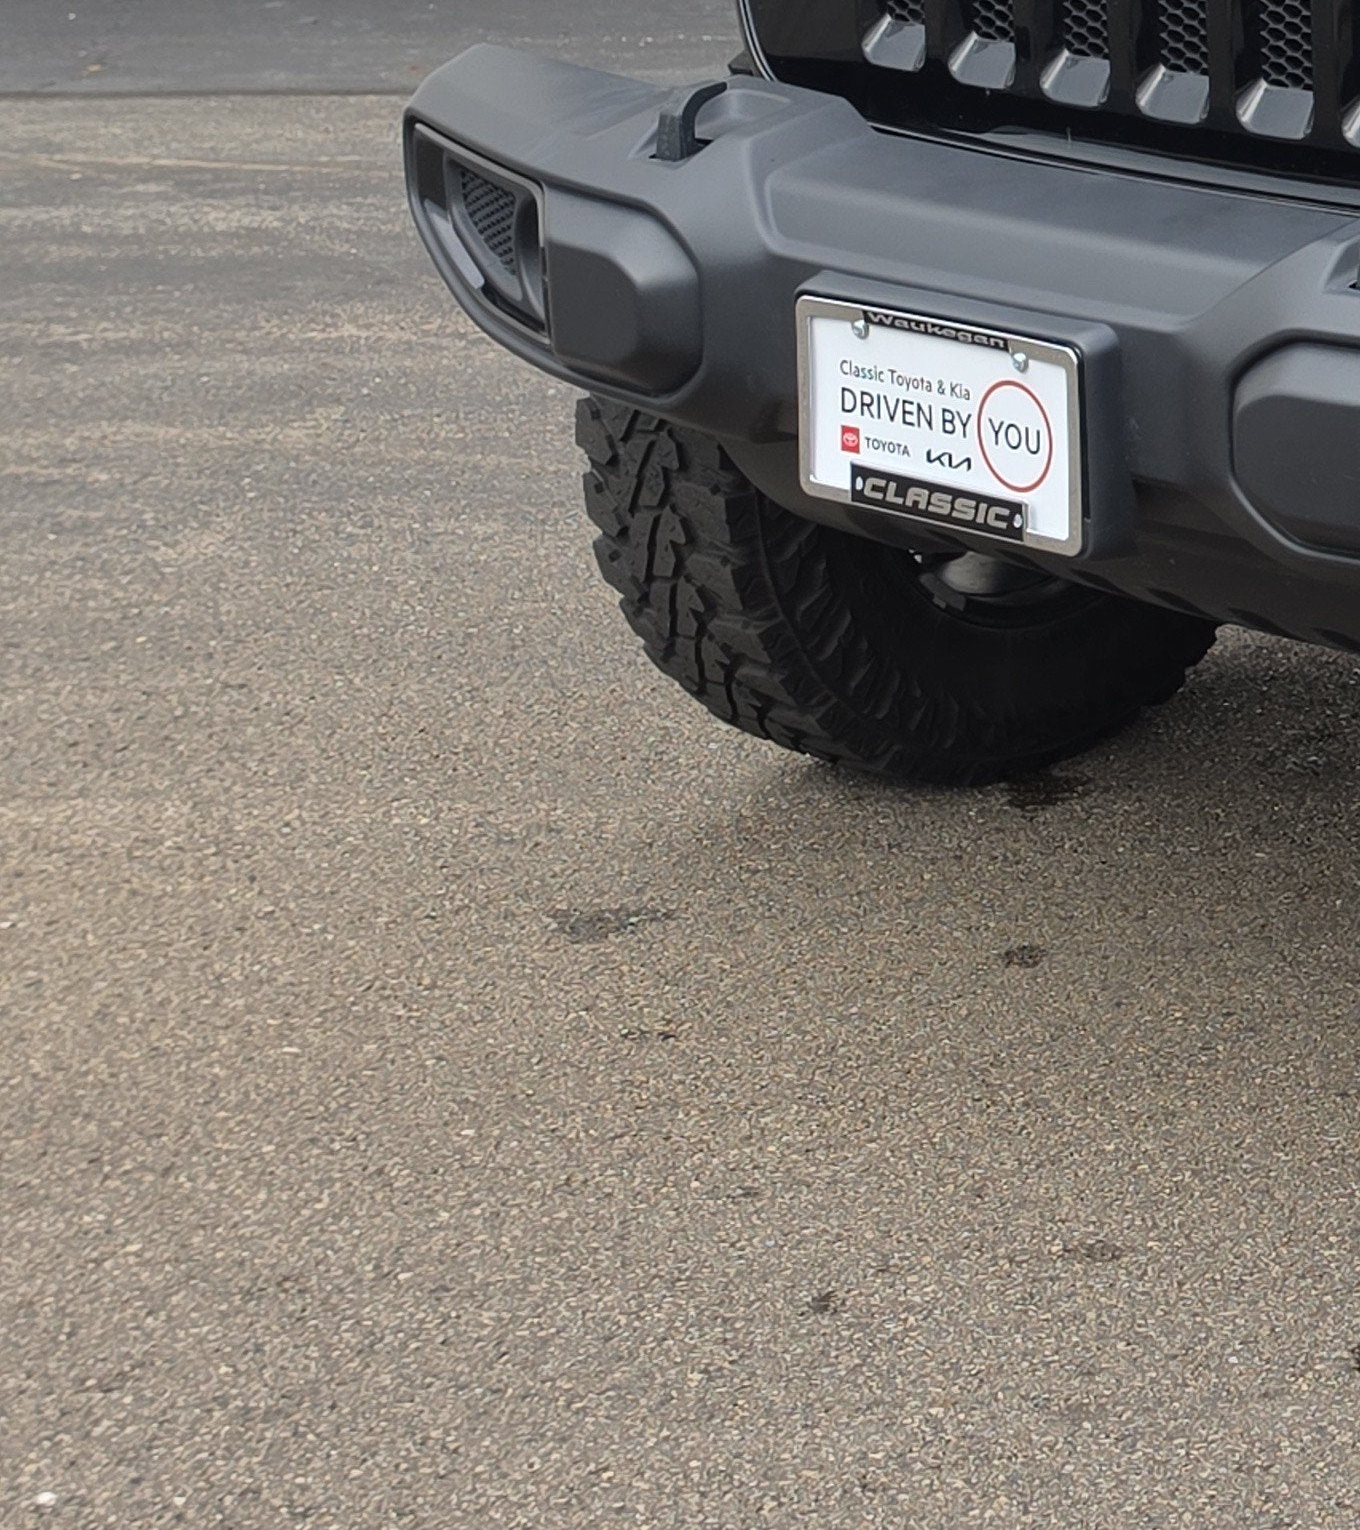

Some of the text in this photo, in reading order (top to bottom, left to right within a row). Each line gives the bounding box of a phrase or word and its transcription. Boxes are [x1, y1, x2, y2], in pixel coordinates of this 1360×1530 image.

[867, 311, 1006, 350] Waukegan
[839, 359, 971, 401] Classic Toyota & Kia
[840, 387, 1041, 456] DRIVEN BY YOU
[864, 436, 911, 458] TOYOTA
[863, 476, 1011, 530] CLASSIC
